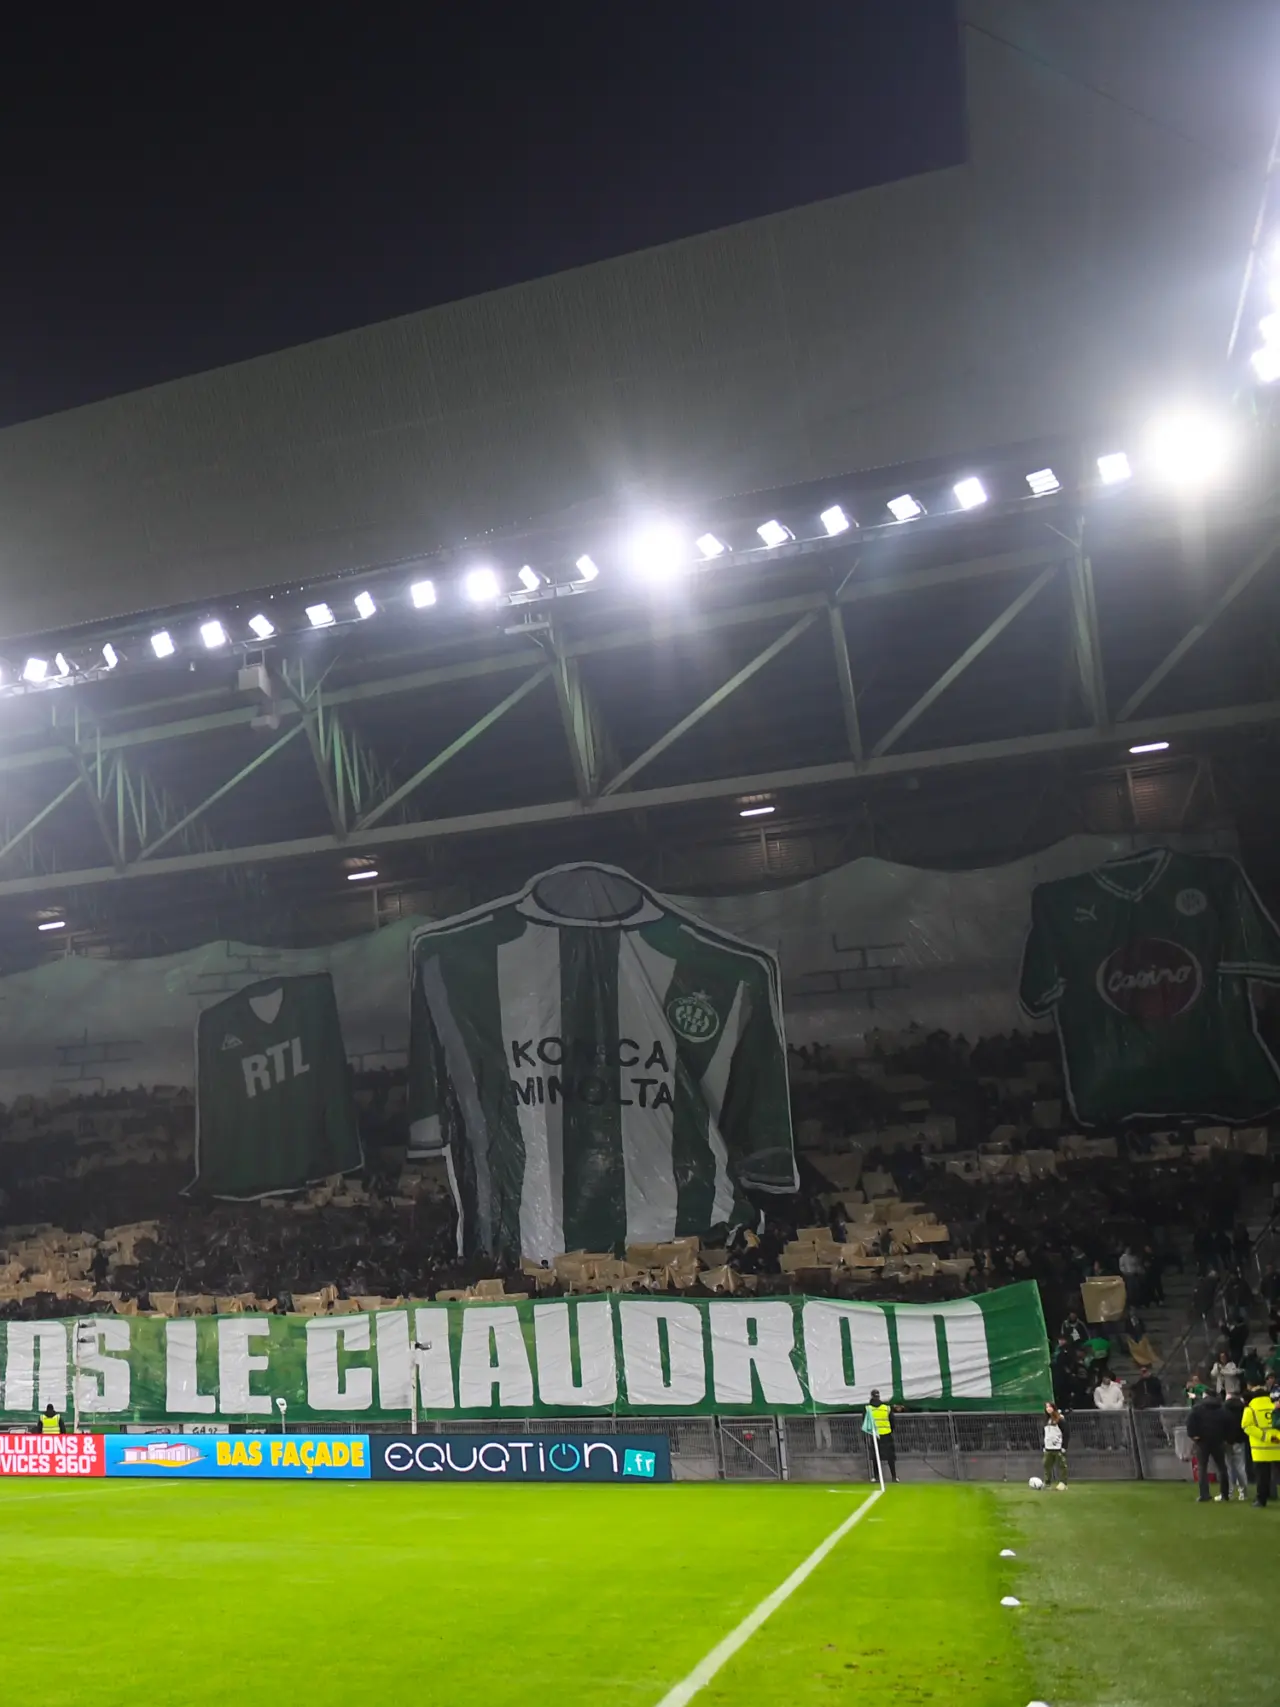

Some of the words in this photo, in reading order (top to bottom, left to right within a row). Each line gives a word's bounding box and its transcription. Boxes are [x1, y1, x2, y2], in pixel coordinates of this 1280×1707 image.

[241, 1037, 309, 1099] RTL
[512, 1037, 669, 1073] KOCA
[165, 1317, 273, 1414] LE
[305, 1297, 992, 1411] CHAUDRON
[83, 1436, 97, 1456] &
[216, 1440, 263, 1467] BAS
[270, 1440, 365, 1474] FAÇADE
[55, 1455, 98, 1474] 360°
